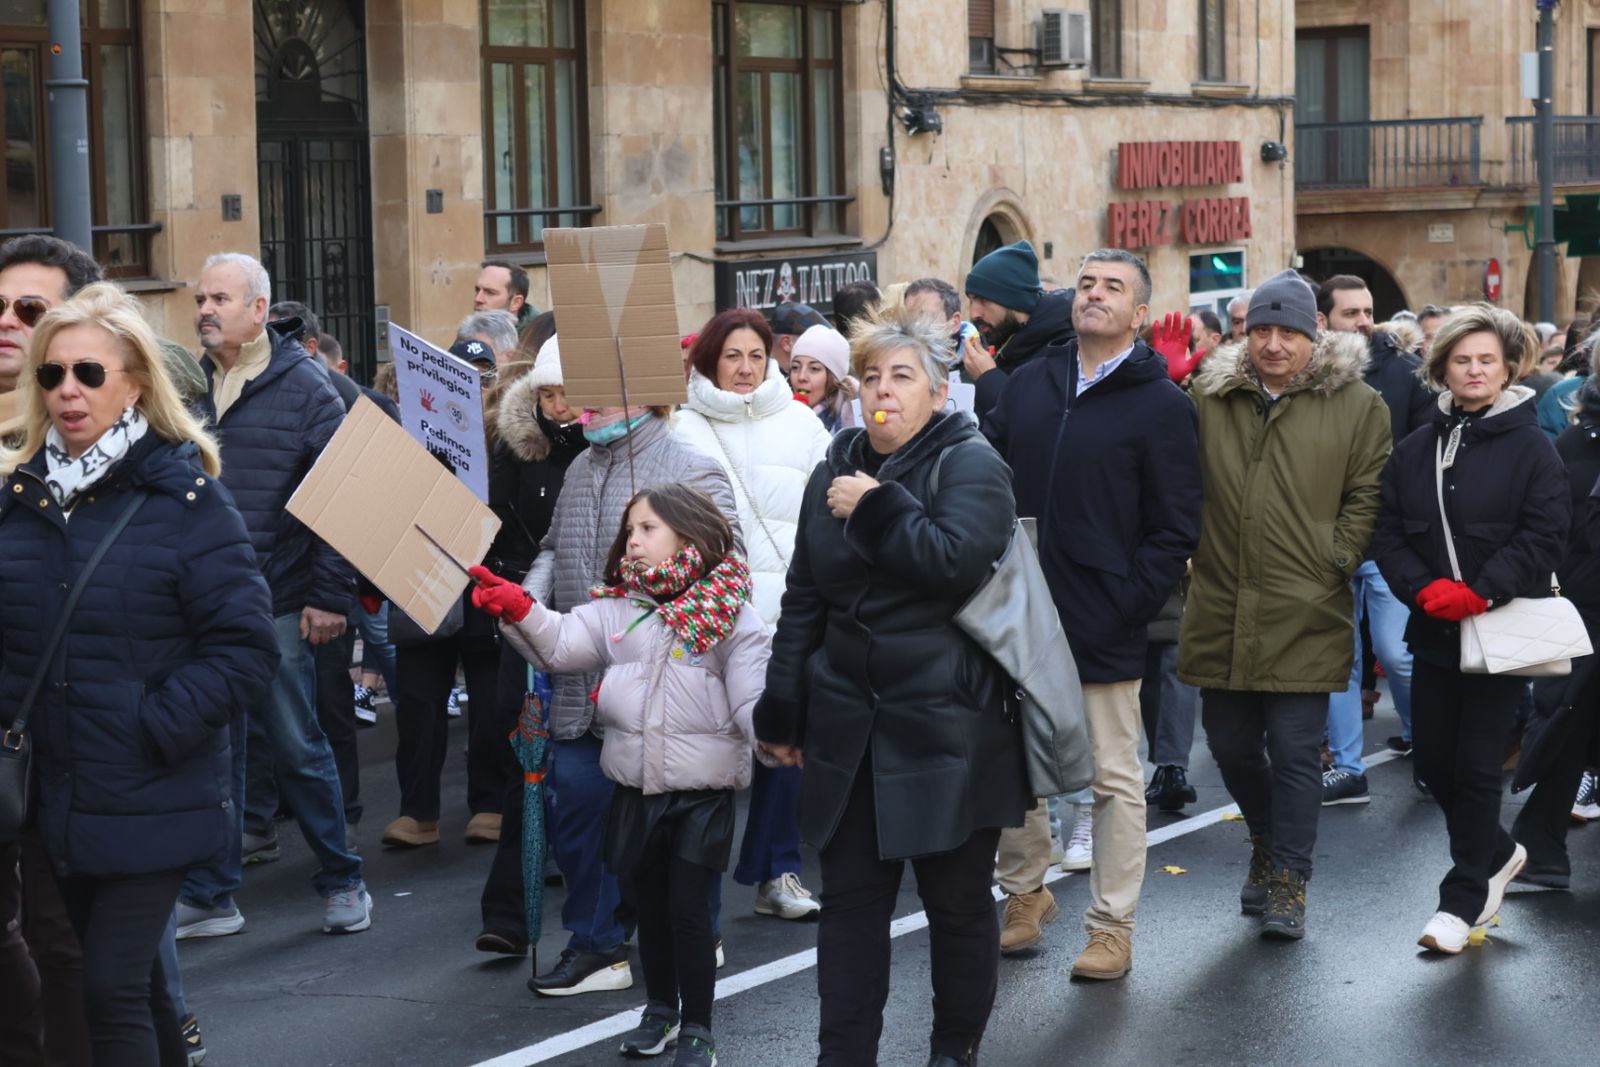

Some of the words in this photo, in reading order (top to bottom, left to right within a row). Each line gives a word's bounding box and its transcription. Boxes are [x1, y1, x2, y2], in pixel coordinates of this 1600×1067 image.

[1118, 141, 1244, 189] INMOBILIARIA
[1108, 200, 1173, 248] PEREZ
[1181, 197, 1252, 244] CORREA
[736, 268, 776, 310] NEZ
[400, 336, 418, 355] No
[422, 351, 473, 385] pedimos
[407, 359, 471, 400] privilegios
[421, 419, 471, 457] Pedimos
